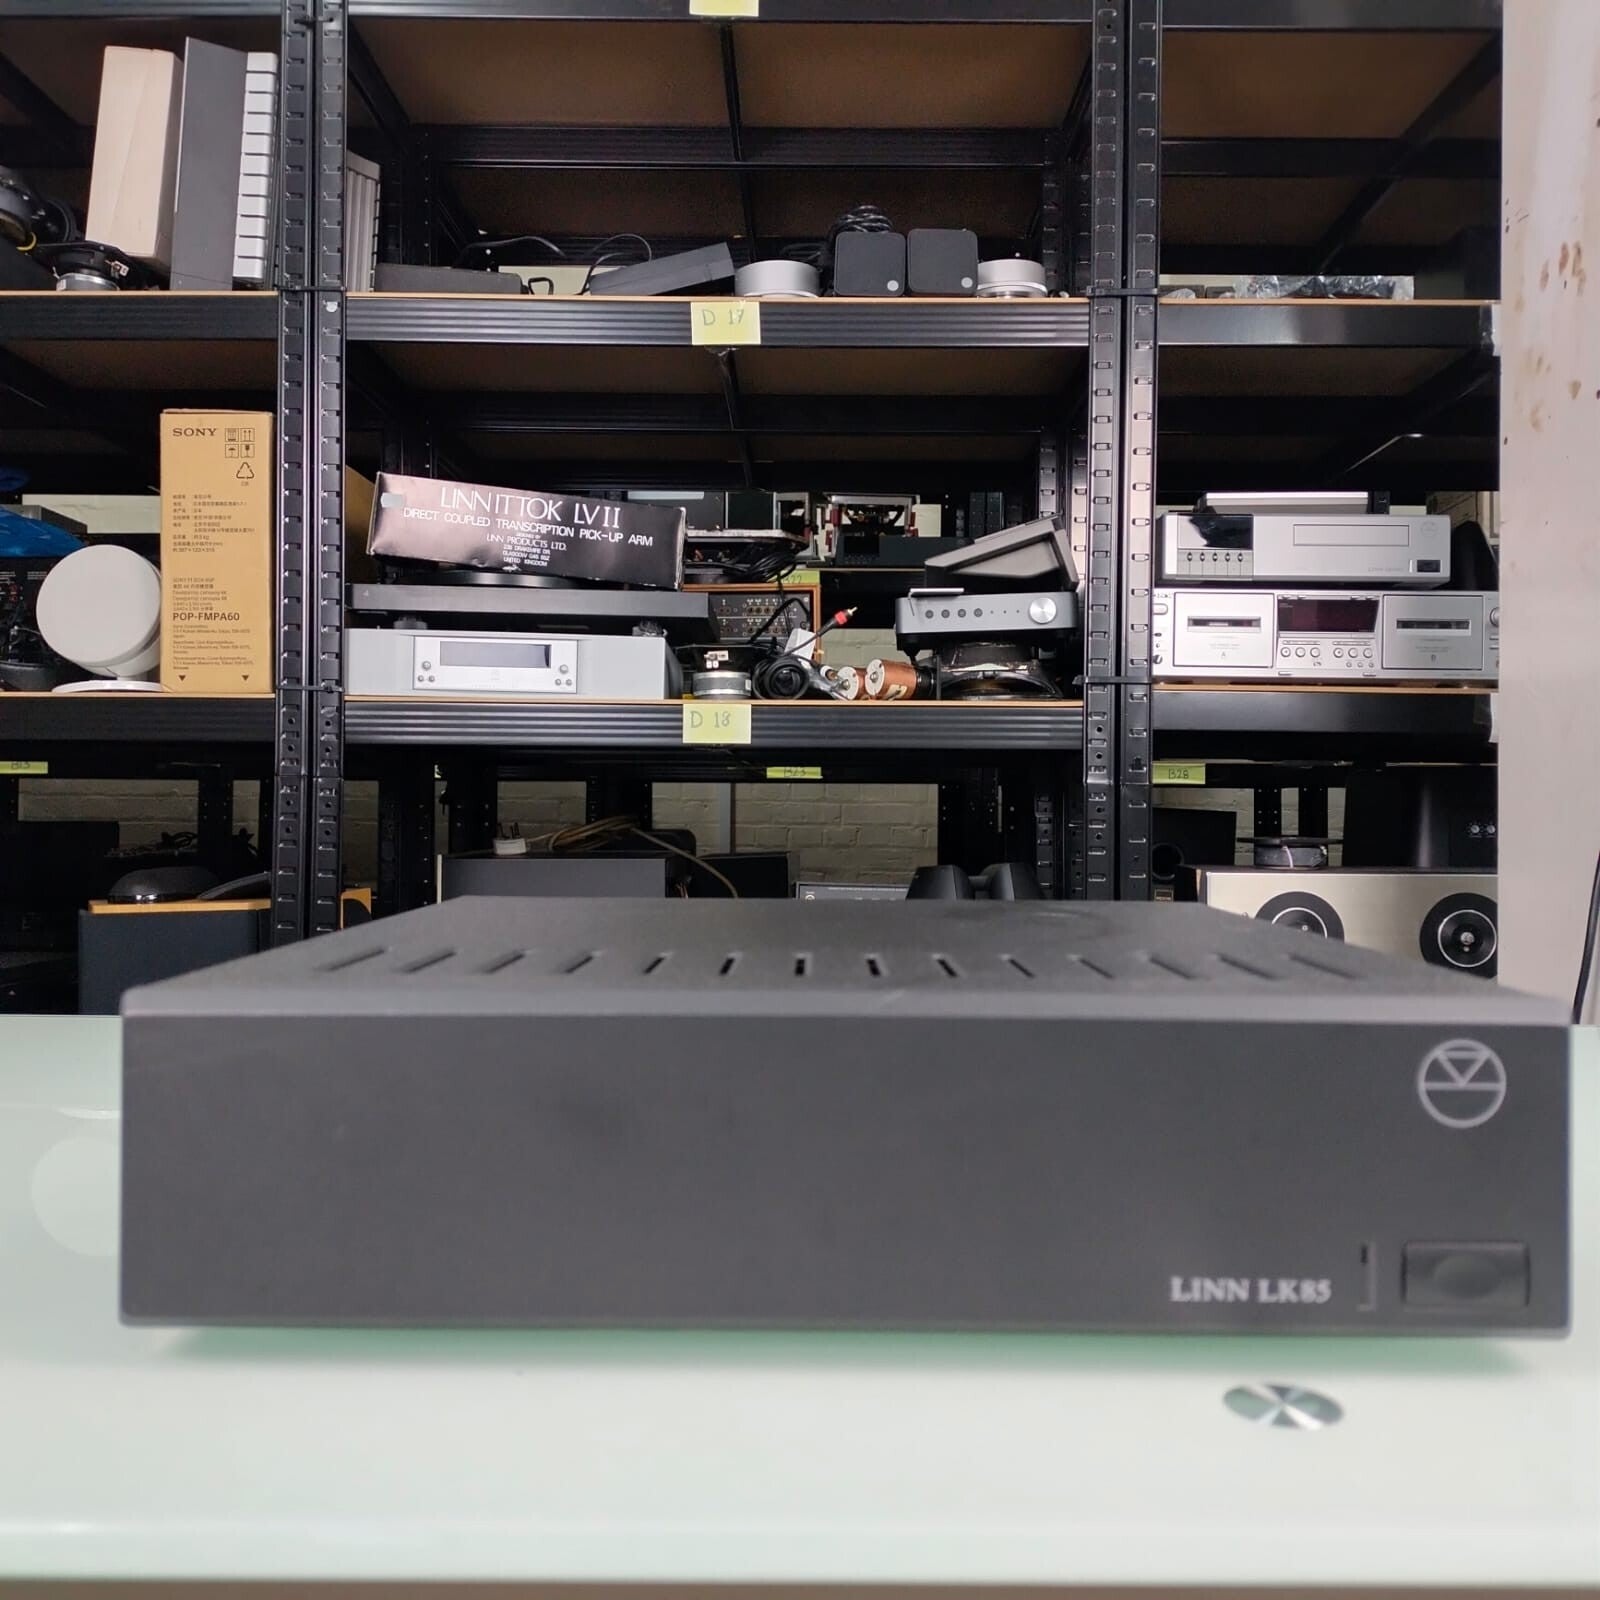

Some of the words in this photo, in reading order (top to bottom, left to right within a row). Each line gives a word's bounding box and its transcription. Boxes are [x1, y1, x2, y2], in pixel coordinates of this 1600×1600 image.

[702, 309, 716, 326] D
[728, 308, 745, 325] 17
[172, 427, 217, 437] SONY
[440, 487, 492, 513] LINN
[403, 507, 440, 520] DIRECT
[444, 512, 490, 526] COUPLED
[495, 518, 574, 537] TRANSCRIPTION
[579, 528, 624, 543] PICK-UP
[628, 534, 653, 546] ARM
[486, 533, 504, 542] LINN
[506, 535, 549, 548] PRODUCTS
[172, 612, 240, 621] POP-FMPA60
[690, 710, 704, 728] D
[714, 710, 732, 728] 18
[1170, 1275, 1250, 1303] LINN
[1257, 1277, 1332, 1304] LK85
